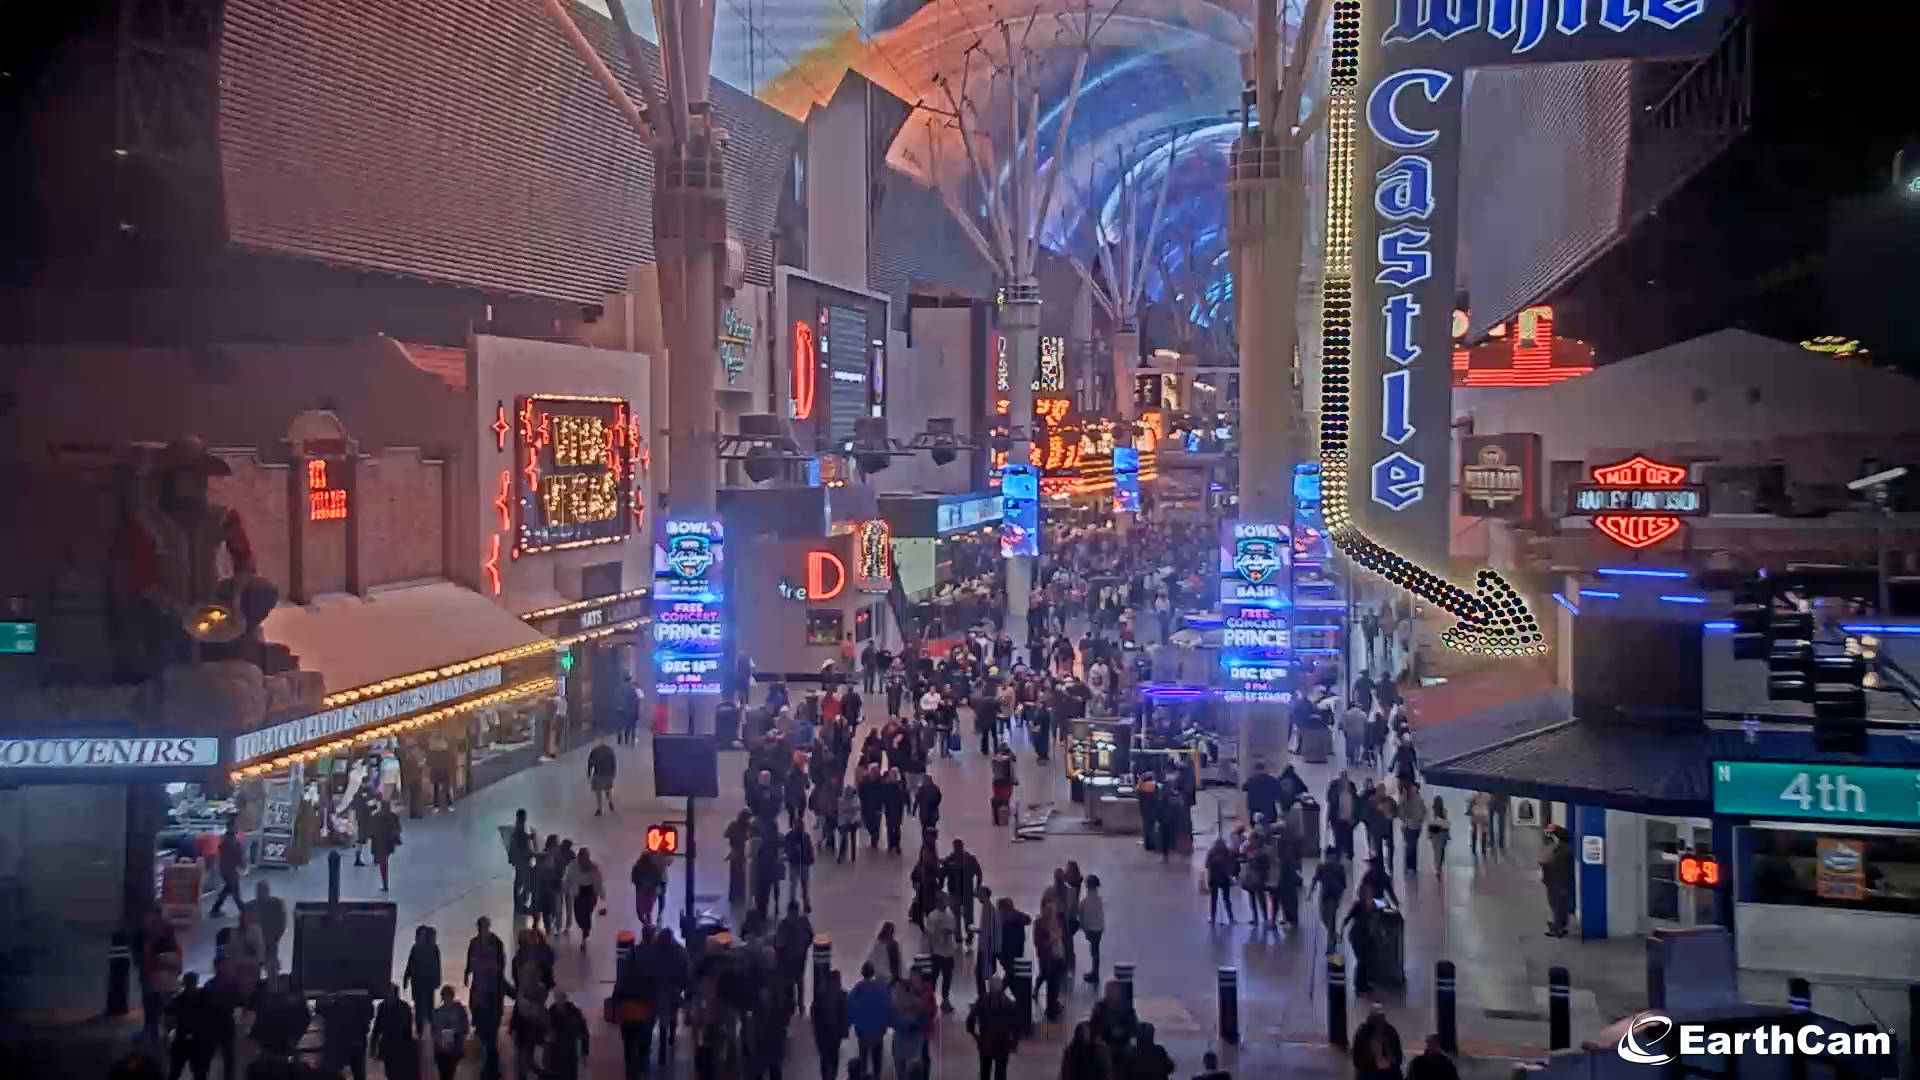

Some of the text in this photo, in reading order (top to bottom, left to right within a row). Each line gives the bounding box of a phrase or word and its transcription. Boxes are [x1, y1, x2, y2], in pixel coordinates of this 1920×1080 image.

[1366, 69, 1452, 511] Castle
[1607, 462, 1670, 484] MOTOR
[666, 521, 712, 534] BOWL
[808, 551, 845, 599] D
[1236, 585, 1275, 598] BASH
[673, 603, 703, 613] FREE
[1241, 608, 1271, 619] FREE
[660, 612, 718, 622] CONCERT
[658, 623, 721, 640] PRINCE
[1223, 629, 1291, 648] PRINCE
[661, 660, 691, 674] DEC
[1230, 667, 1259, 680] DEC
[0, 739, 197, 765] OUVENIRS
[1717, 765, 1867, 813] N 4th
